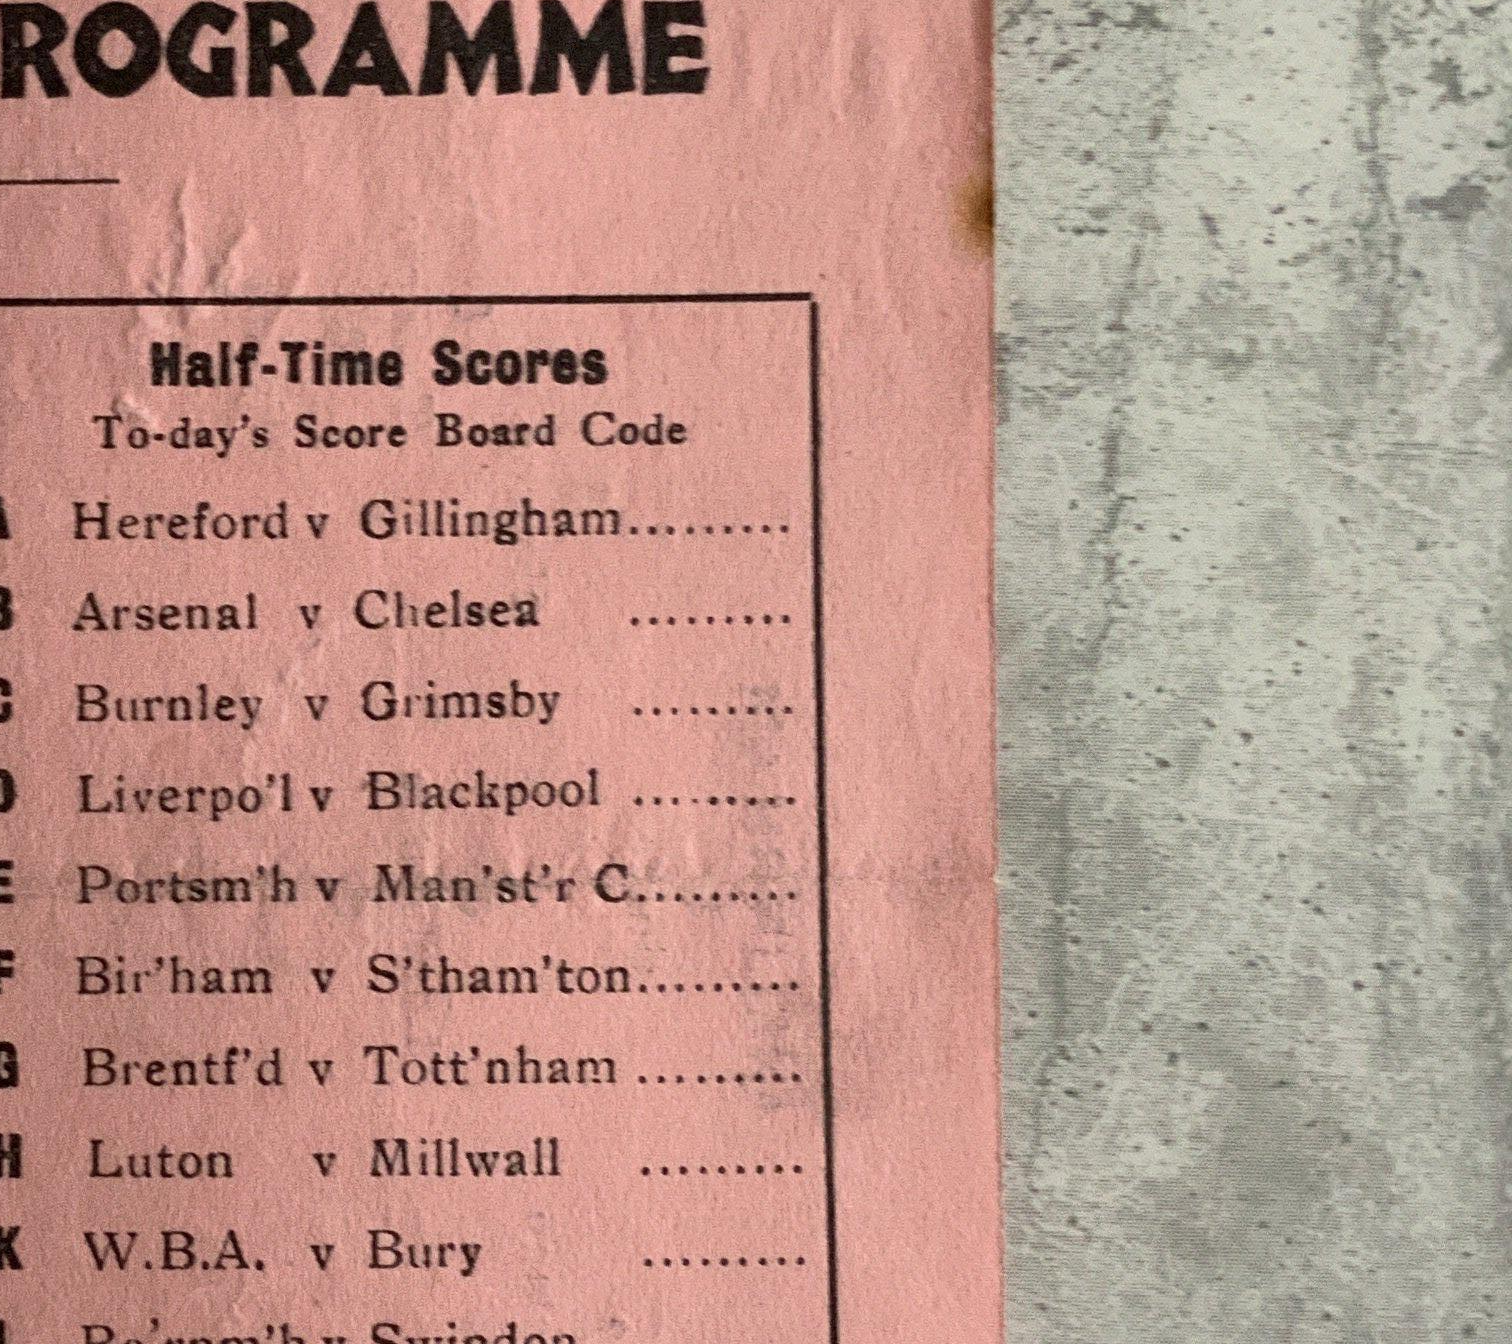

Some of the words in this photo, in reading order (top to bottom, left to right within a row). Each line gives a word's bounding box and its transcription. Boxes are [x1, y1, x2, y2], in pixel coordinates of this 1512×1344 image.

[150, 341, 403, 387] Half-Time
[432, 339, 608, 386] Scores
[93, 414, 269, 458] To-day's
[295, 414, 406, 449] Score
[435, 413, 555, 447] Board
[581, 411, 687, 446] Code
[73, 501, 288, 540] Hereford
[306, 514, 329, 539] v
[72, 592, 256, 631] Arsenal
[299, 605, 321, 629] v
[354, 590, 539, 629] Chelsea
[77, 684, 261, 730] Burnley
[304, 695, 328, 720] v
[361, 680, 560, 725] Grimsby
[79, 773, 292, 822] Liverpo'l
[310, 787, 333, 812] v
[362, 768, 599, 816] Blackpool
[77, 864, 296, 904] Portsm'h
[315, 878, 340, 902] v
[373, 864, 575, 903] Man'st'r
[76, 956, 272, 995] Bir'ham
[311, 968, 335, 993] v
[83, 1047, 283, 1087] Brentf'd
[308, 1060, 333, 1085] v
[363, 1045, 616, 1085] Tott'nham
[89, 1139, 233, 1179] Luton
[313, 1153, 336, 1176] v
[370, 1137, 560, 1177] Millwall
[84, 1230, 264, 1271] W.B.A.
[310, 1244, 334, 1270] v
[368, 1229, 481, 1277] Bury
